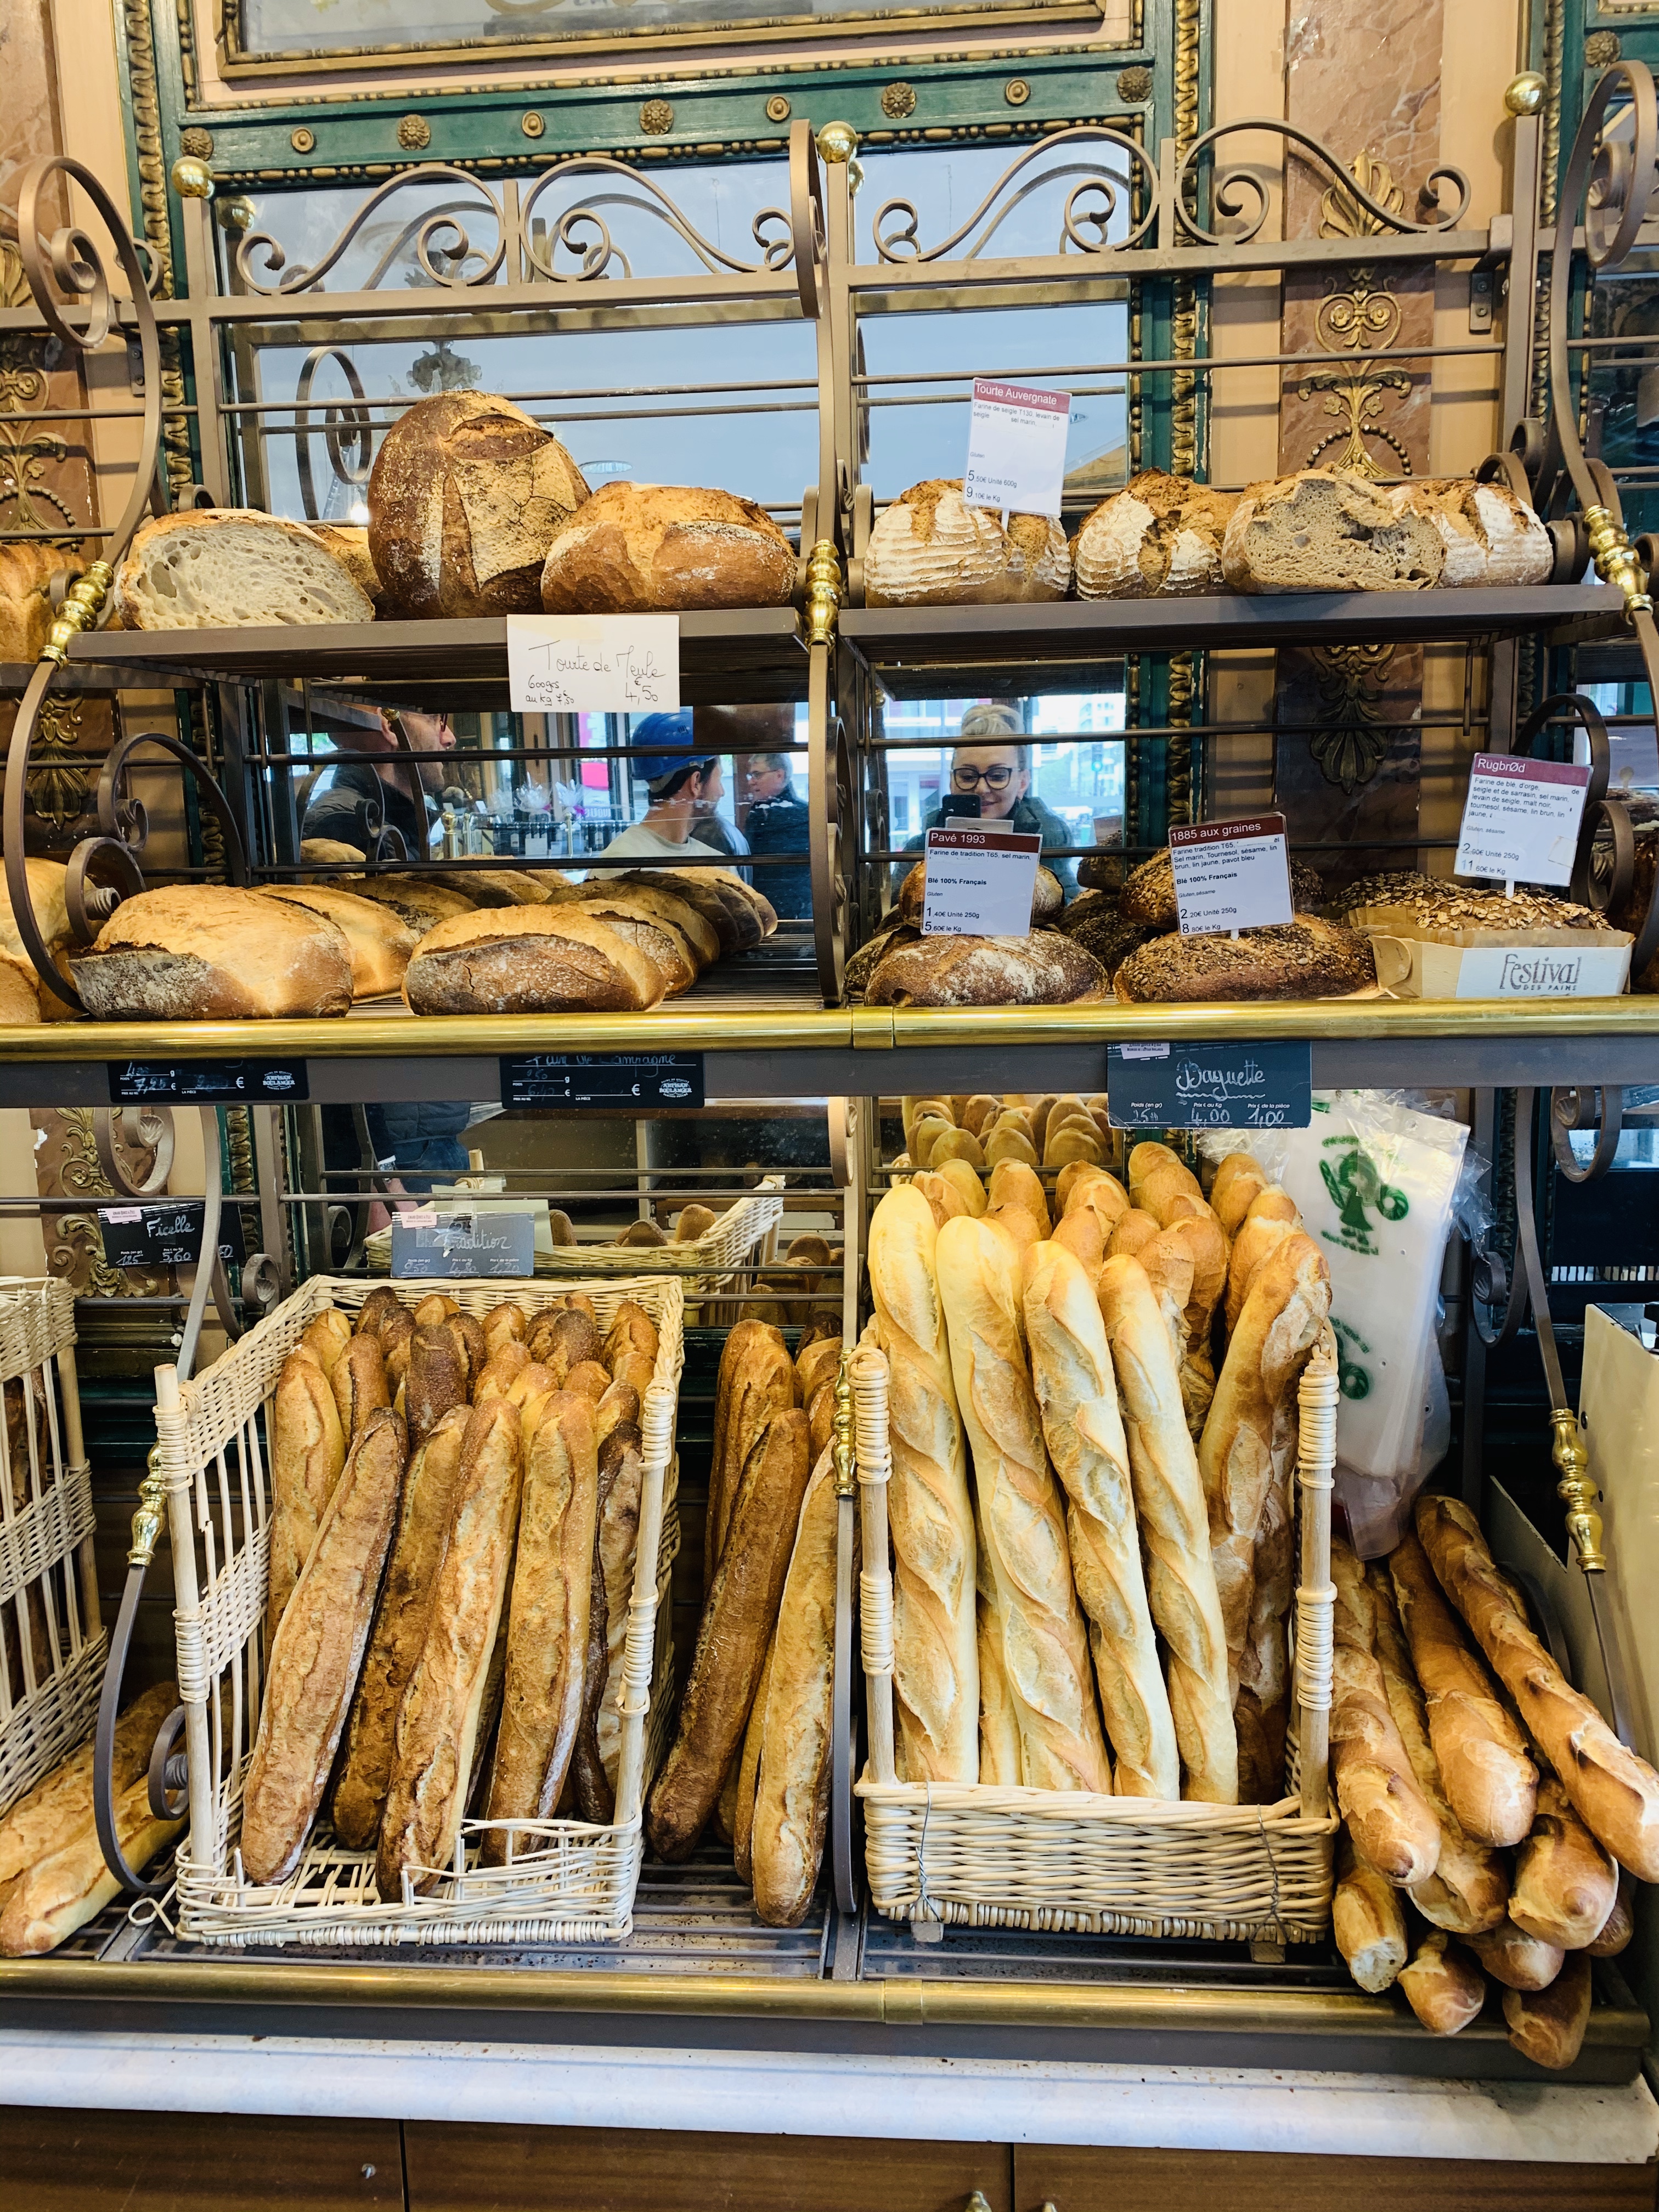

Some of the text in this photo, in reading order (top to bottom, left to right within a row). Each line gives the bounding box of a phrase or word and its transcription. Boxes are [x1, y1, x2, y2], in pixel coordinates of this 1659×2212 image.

[975, 382, 1057, 405] Tourte Auvergnate
[974, 402, 991, 411] Farine
[1019, 409, 1034, 417] T130,
[1036, 411, 1051, 420] levain
[1003, 479, 1017, 488] 600g
[528, 640, 666, 678] Tourte de Meule
[528, 675, 560, 693] 600grs
[526, 694, 538, 703] au
[540, 693, 552, 706] kg
[1477, 758, 1526, 773] RugbrØd
[1475, 777, 1494, 786] Farine
[1519, 783, 1540, 791] d'orge,
[1502, 798, 1521, 806] seigle,
[1510, 791, 1537, 799] sarrasin,
[1468, 810, 1488, 819] jaune,
[1470, 803, 1500, 812] tournesol,
[1503, 805, 1528, 814] sésame,
[1540, 809, 1555, 817] brun,
[931, 833, 985, 844] Pavé 1993
[1172, 823, 1261, 841] 1885 aux graines
[1207, 850, 1239, 858] Tournesol,
[1503, 853, 1519, 861] 250g
[1201, 859, 1221, 868] jaune,
[1222, 856, 1240, 865] pavot
[1499, 953, 1582, 990] Festival
[236, 1076, 245, 1088] €
[1176, 1057, 1266, 1101] Baguette
[631, 1084, 641, 1096] €
[1191, 1108, 1230, 1126] 4,00
[1248, 1108, 1285, 1128] 1,00
[146, 1214, 195, 1238] Ficelle
[162, 1251, 191, 1263] 5,60
